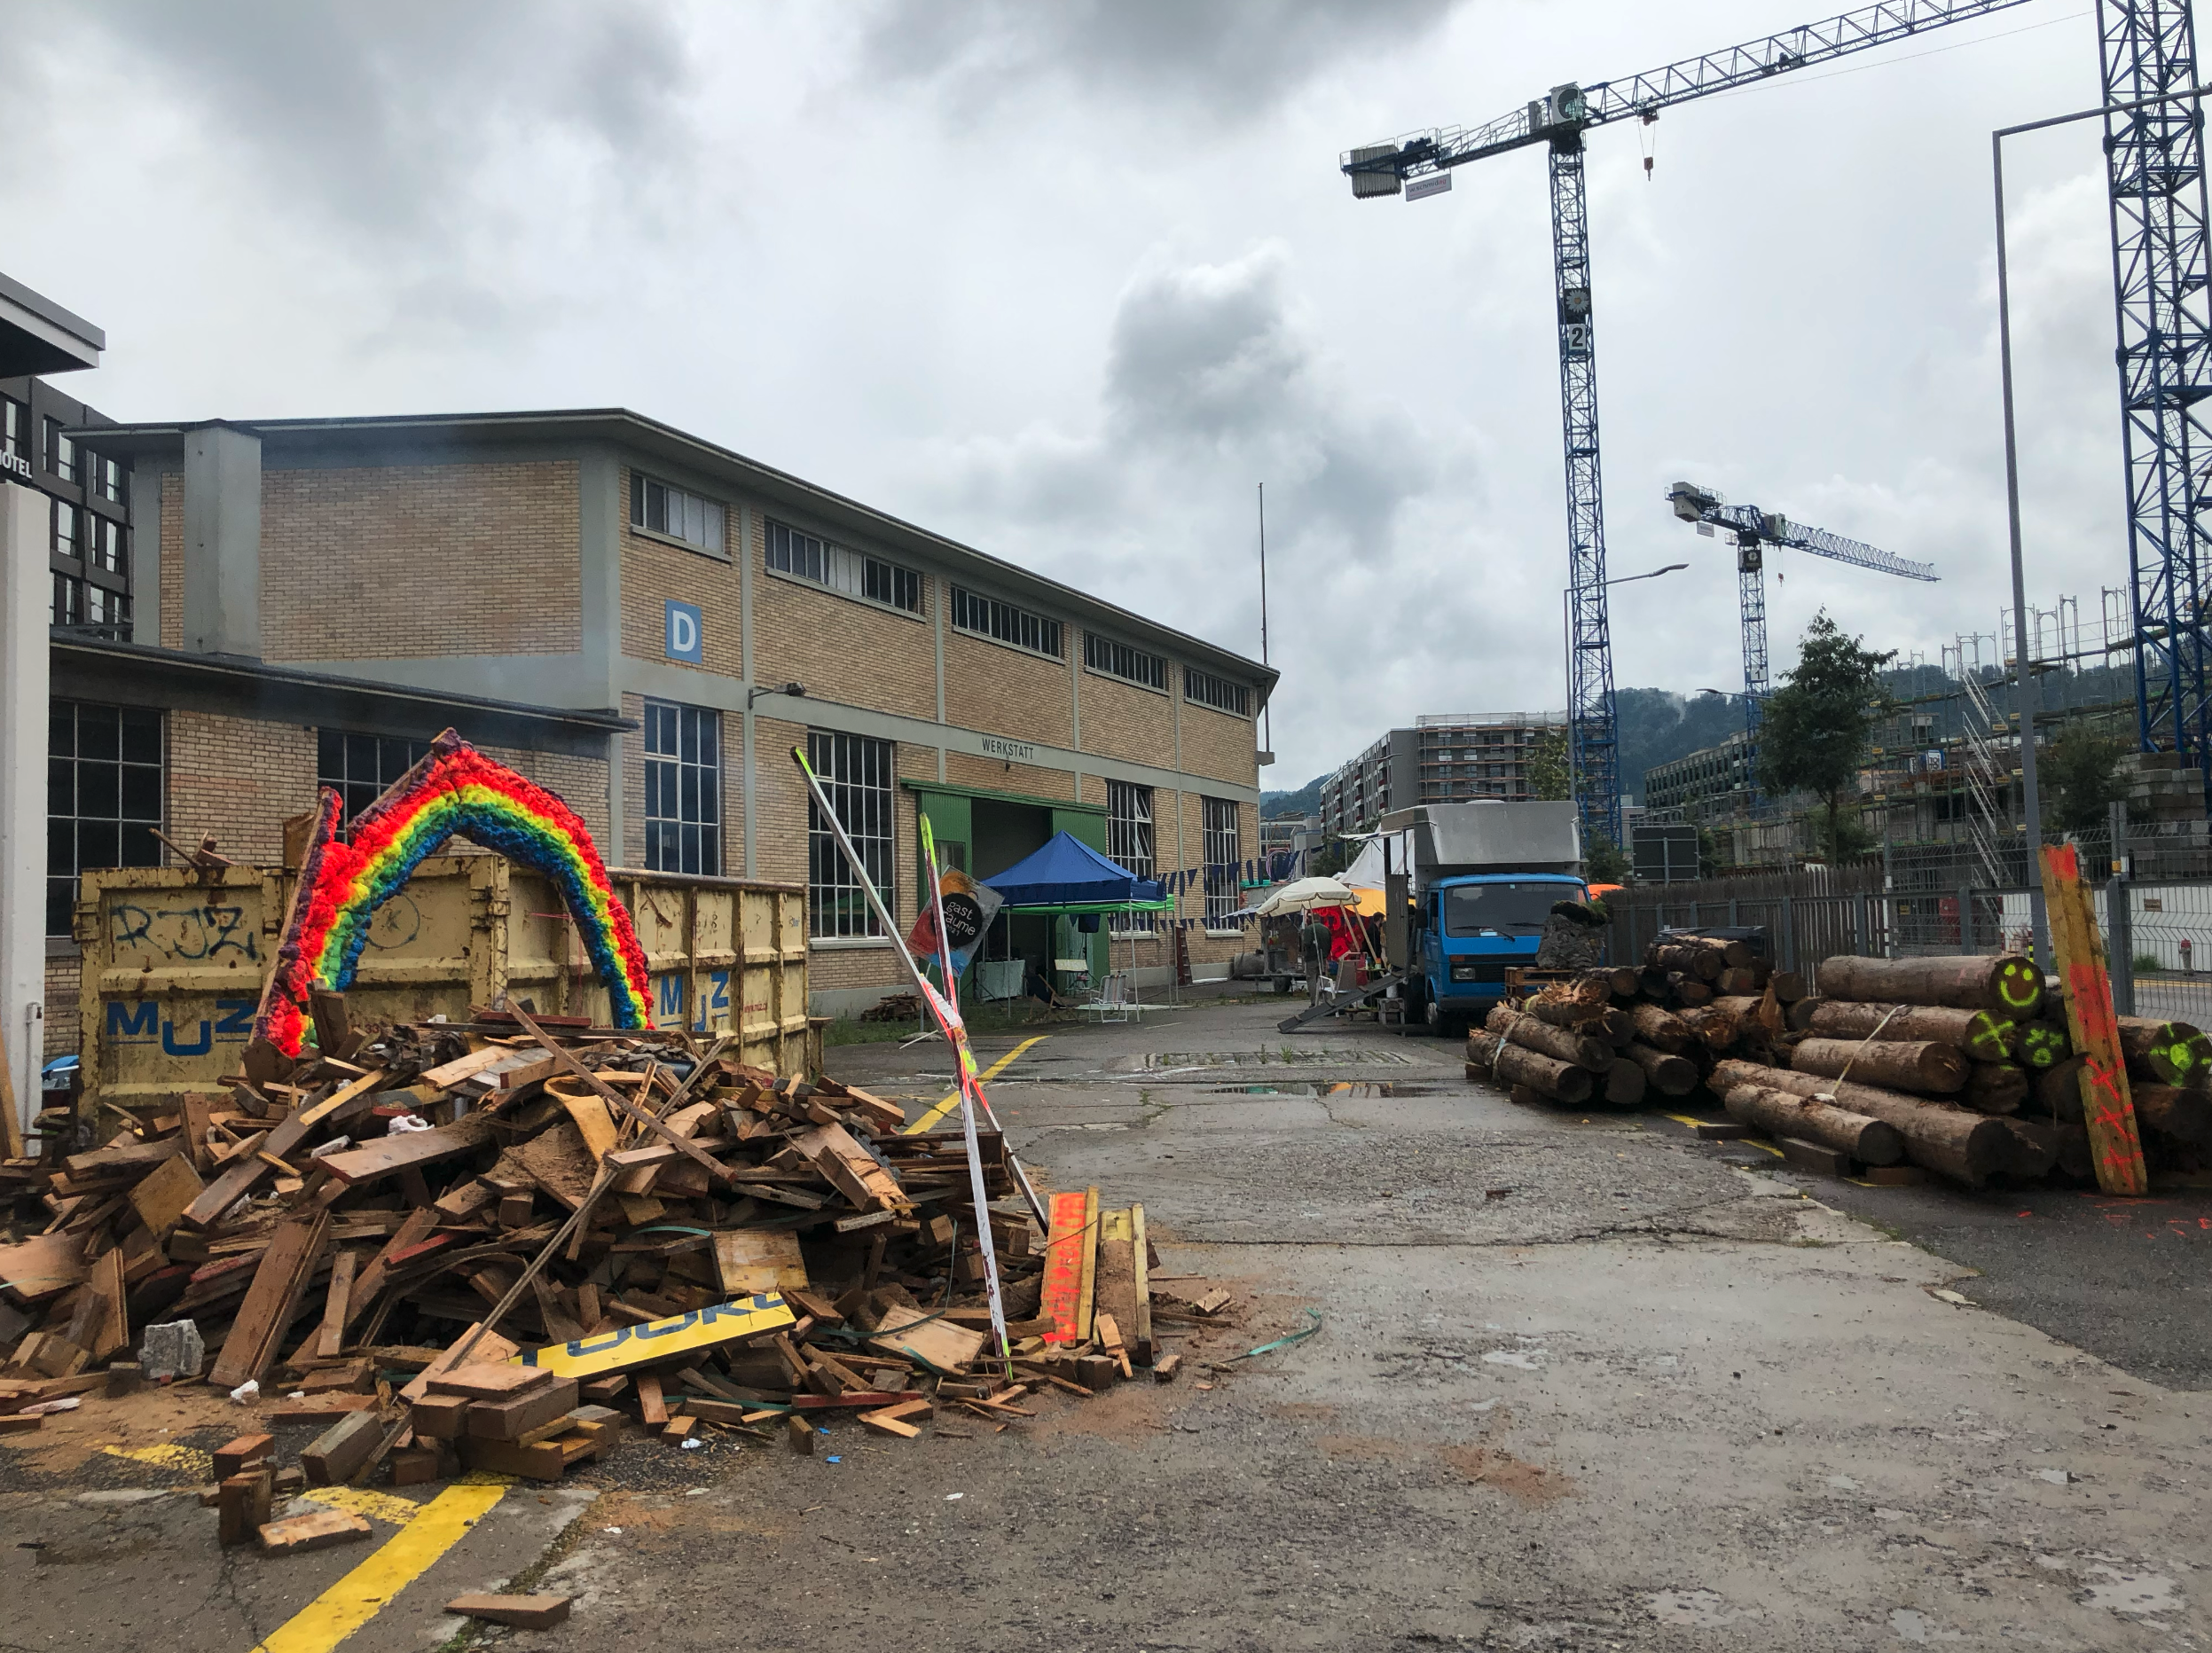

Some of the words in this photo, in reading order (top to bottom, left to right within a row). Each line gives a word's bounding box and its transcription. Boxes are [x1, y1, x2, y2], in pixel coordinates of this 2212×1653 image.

[1572, 326, 1583, 347] 2
[672, 609, 696, 652] D
[1754, 670, 1761, 680] 1
[982, 737, 1034, 760] WERKSTATT
[945, 901, 973, 921] gast
[106, 999, 260, 1056] MUZ
